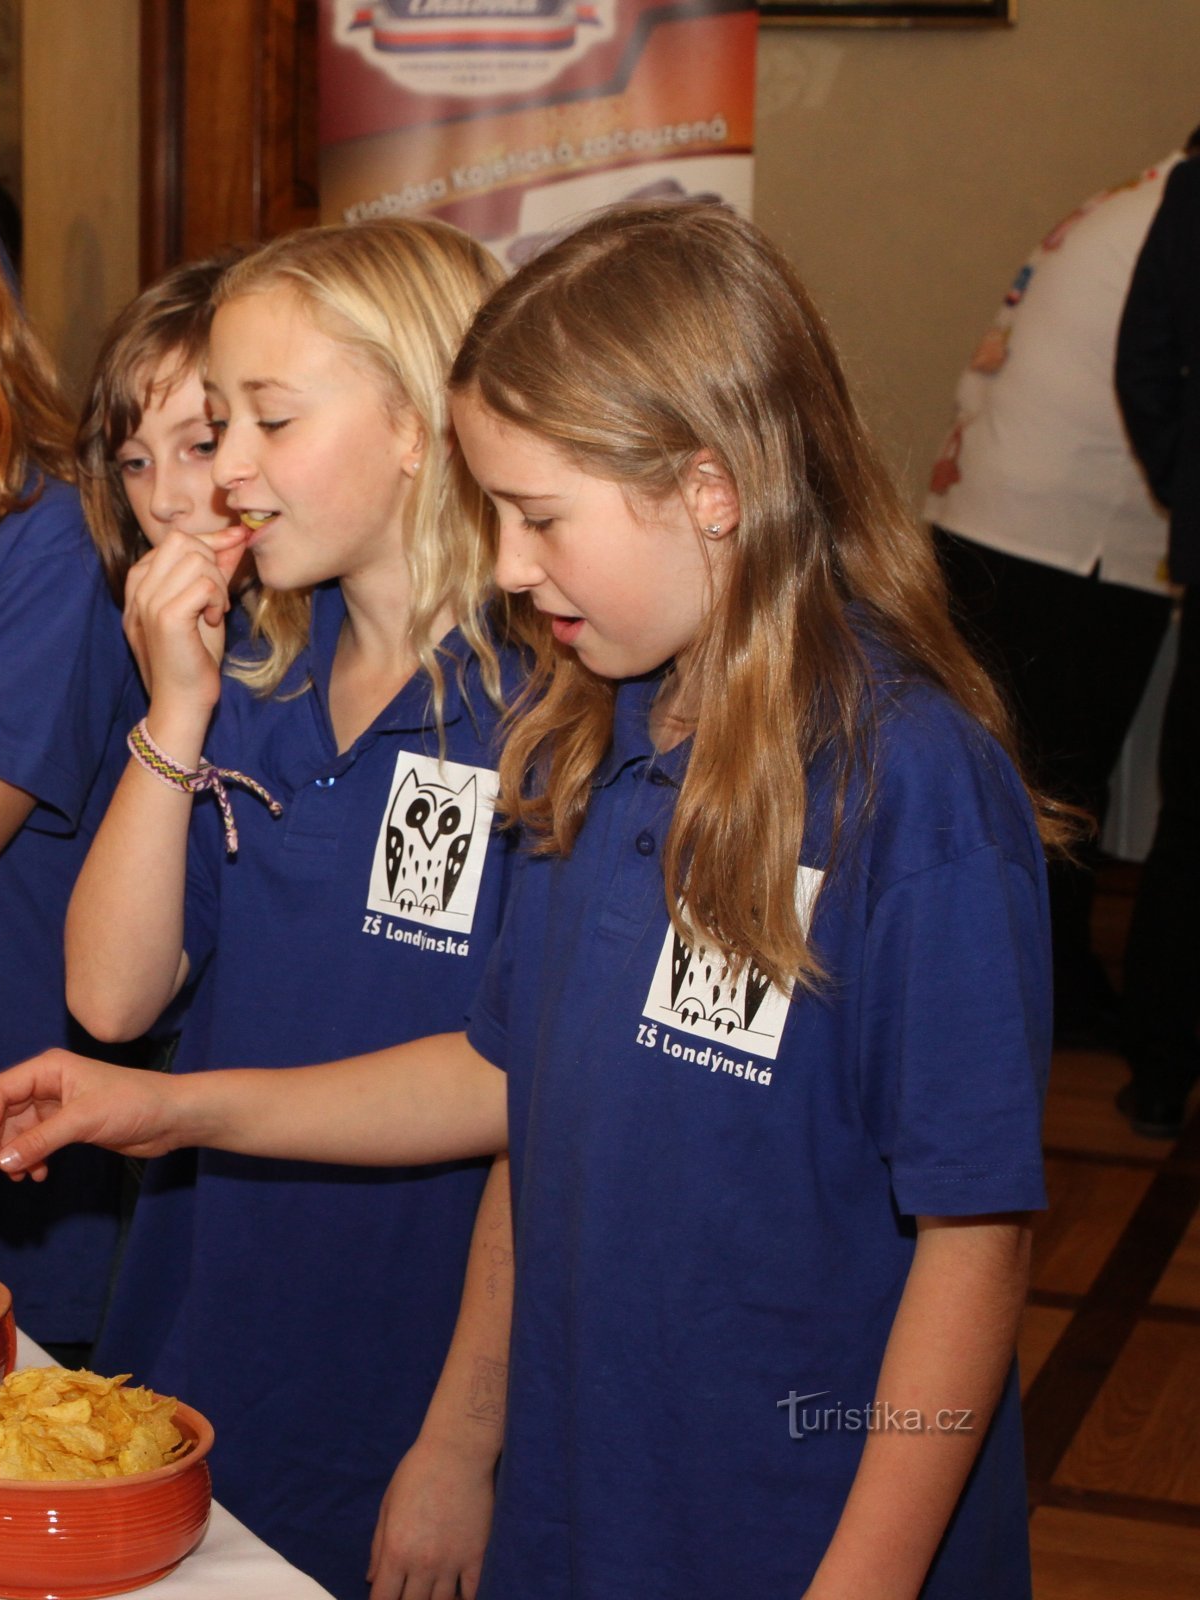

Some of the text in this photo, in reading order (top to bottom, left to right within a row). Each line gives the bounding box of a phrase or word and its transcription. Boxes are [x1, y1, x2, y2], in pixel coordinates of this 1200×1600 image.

[361, 914, 470, 956] ZŠ Londýnská
[635, 1023, 773, 1086] ZŠ Londýnská
